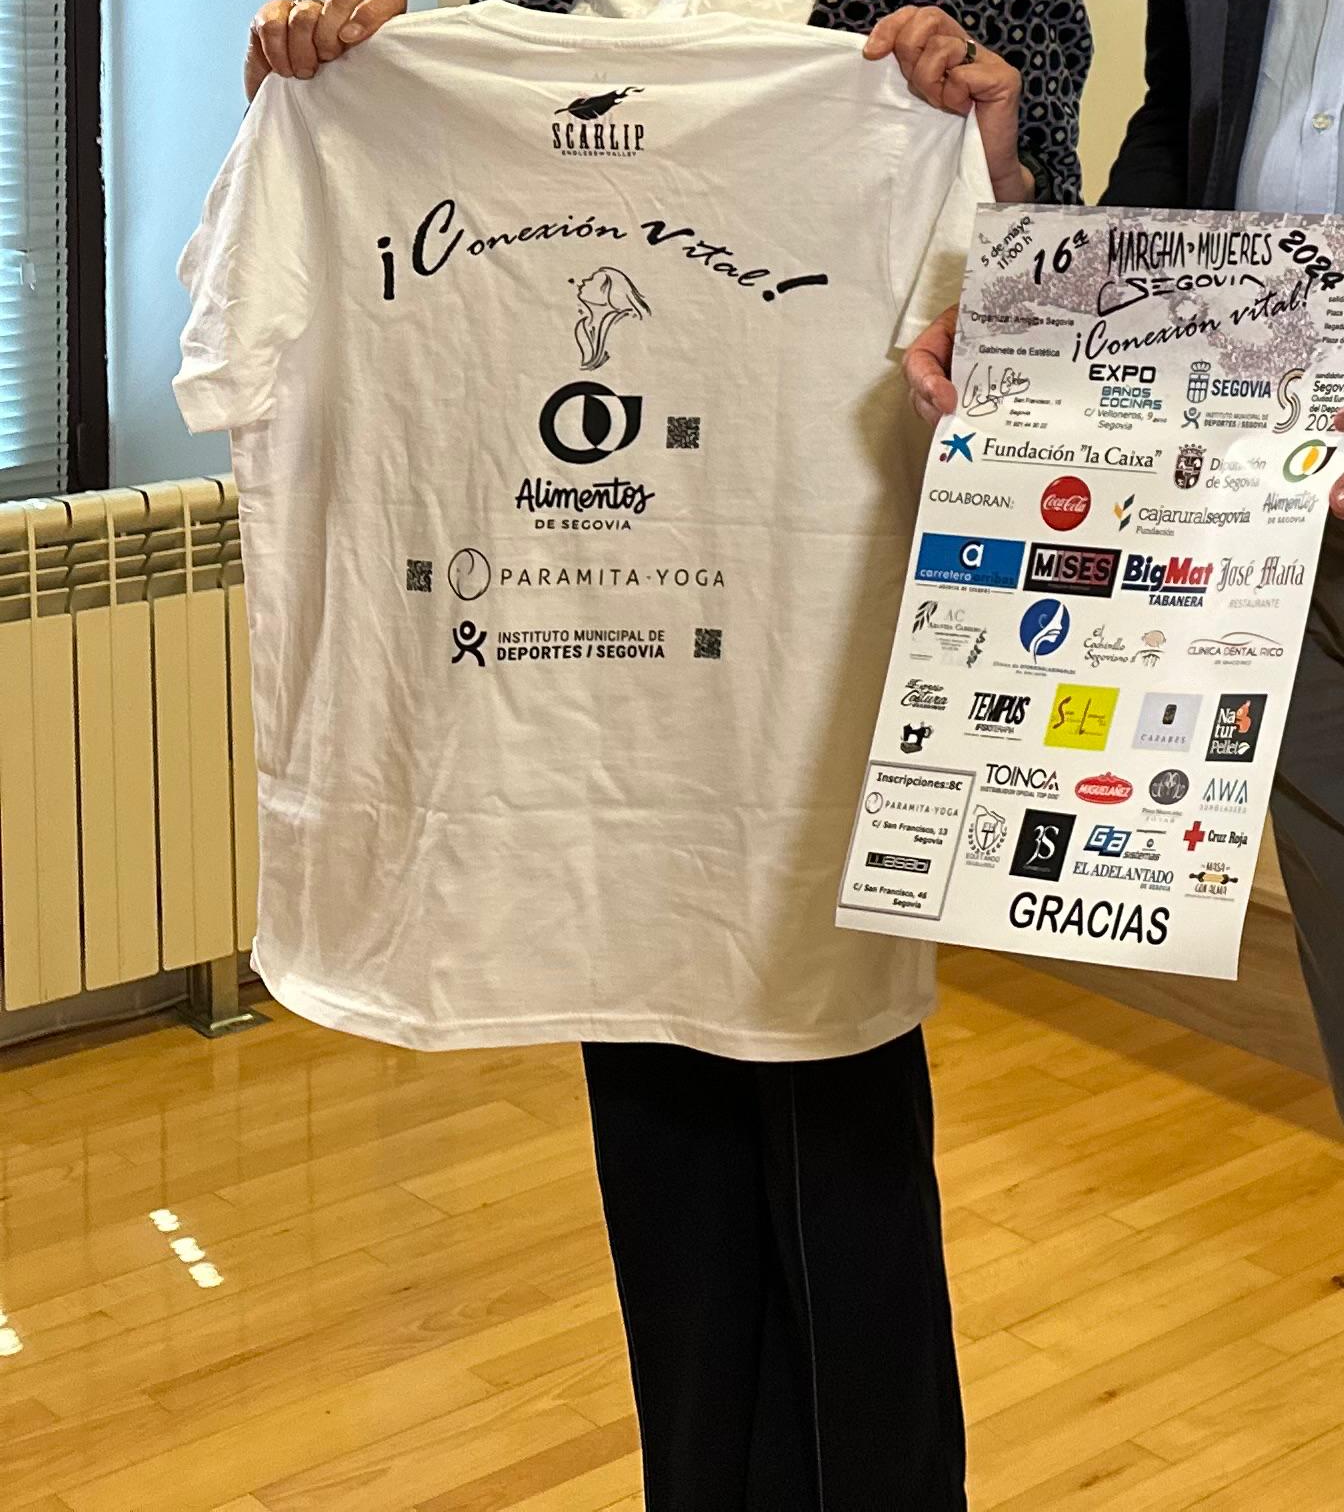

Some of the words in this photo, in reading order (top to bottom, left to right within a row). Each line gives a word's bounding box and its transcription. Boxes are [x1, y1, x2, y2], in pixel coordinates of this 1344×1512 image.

[552, 123, 644, 150] SCARLIP
[1198, 230, 1273, 270] MUJERES
[1089, 364, 1156, 384] EXPO
[1211, 380, 1272, 398] SEGOVIA
[981, 437, 1075, 464] Fundación
[515, 477, 655, 514] Alimentos
[535, 519, 555, 530] DE
[562, 519, 632, 530] SEGOVIA
[500, 568, 640, 586] PARAMITA
[657, 568, 725, 587] YOGA
[1034, 552, 1111, 583] MISES
[1124, 553, 1213, 587] BigMat
[1149, 593, 1204, 608] TABANERA
[498, 631, 570, 644] INSTITUTO
[574, 630, 645, 642] MUNICIPAL
[649, 629, 665, 642] DE
[497, 645, 582, 661] DEPORTES
[597, 645, 665, 659] SEGOVIA
[985, 763, 1060, 792] TOINCA
[1208, 829, 1227, 843] Cruz
[1229, 831, 1248, 846] Roja
[1009, 891, 1170, 945] GRACIAS
